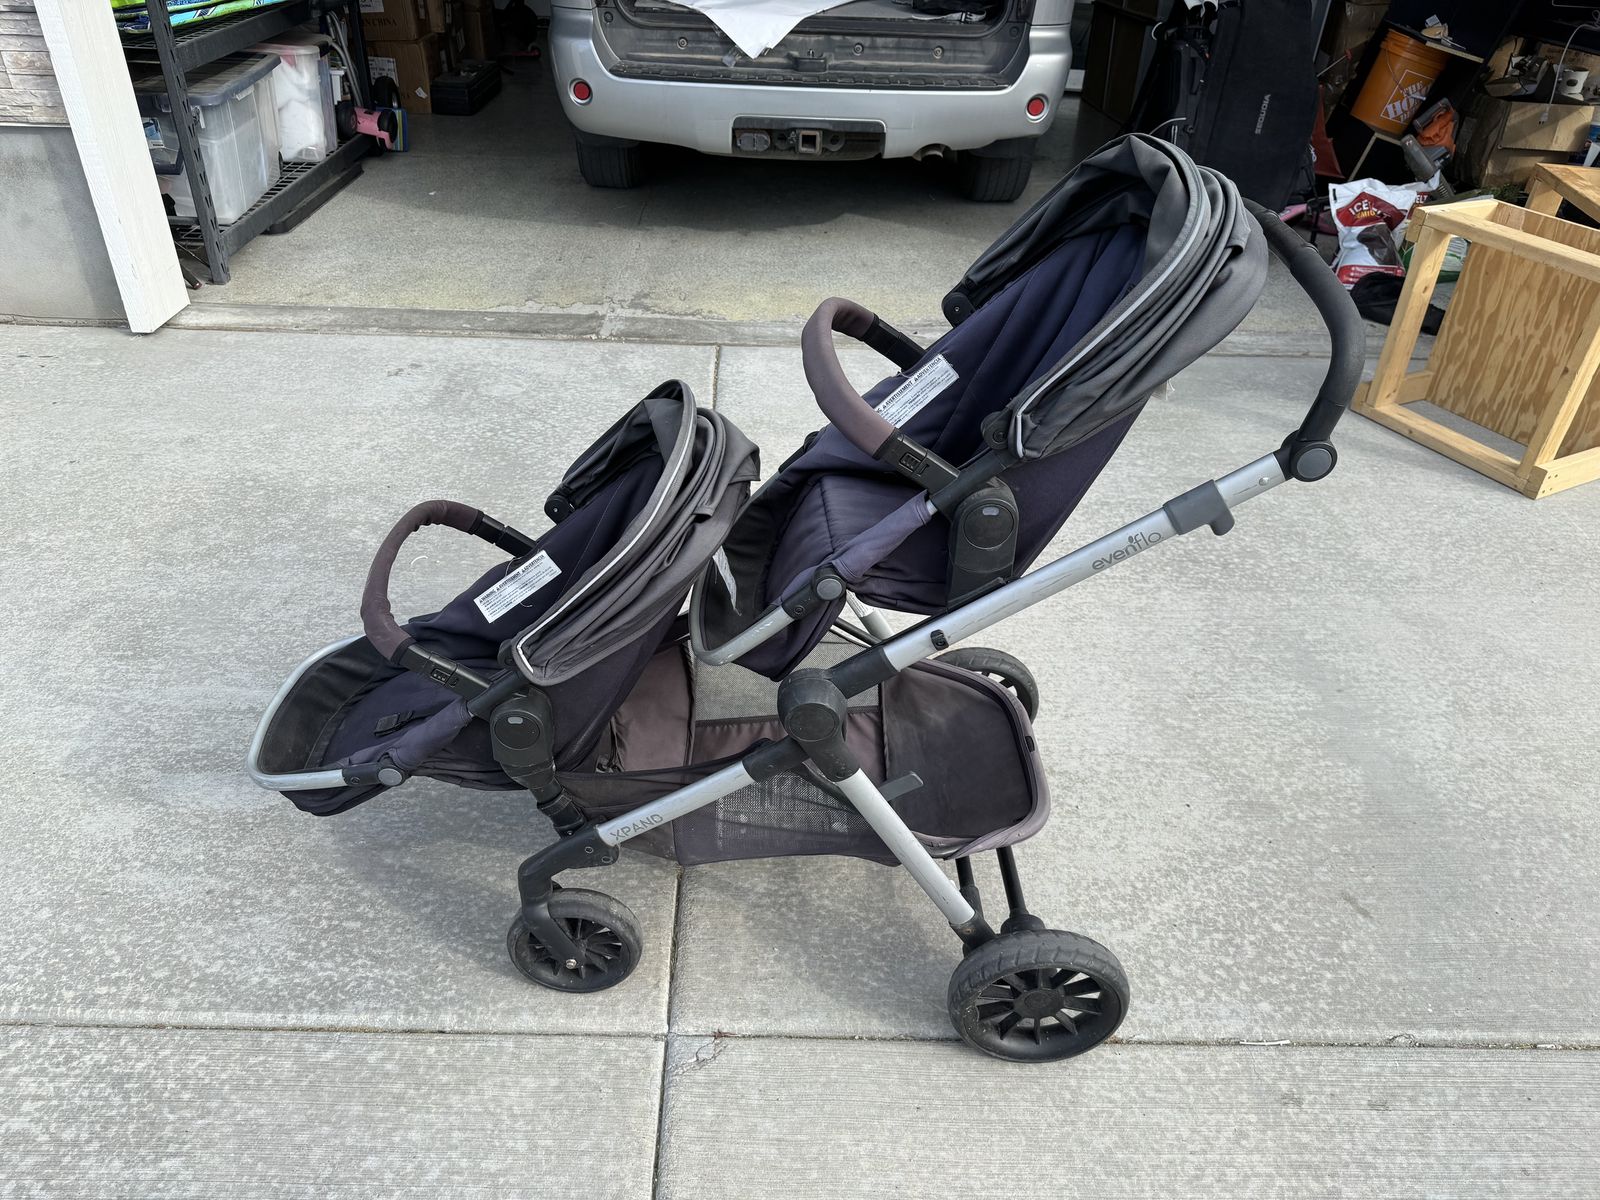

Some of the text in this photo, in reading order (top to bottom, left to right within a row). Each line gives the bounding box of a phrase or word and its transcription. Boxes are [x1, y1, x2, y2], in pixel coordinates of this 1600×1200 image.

[1255, 94, 1271, 134] SEQUOIA
[1349, 199, 1369, 216] ICE
[1416, 195, 1428, 203] ELT
[1092, 532, 1162, 570] evenflo
[610, 814, 664, 841] XPAND
